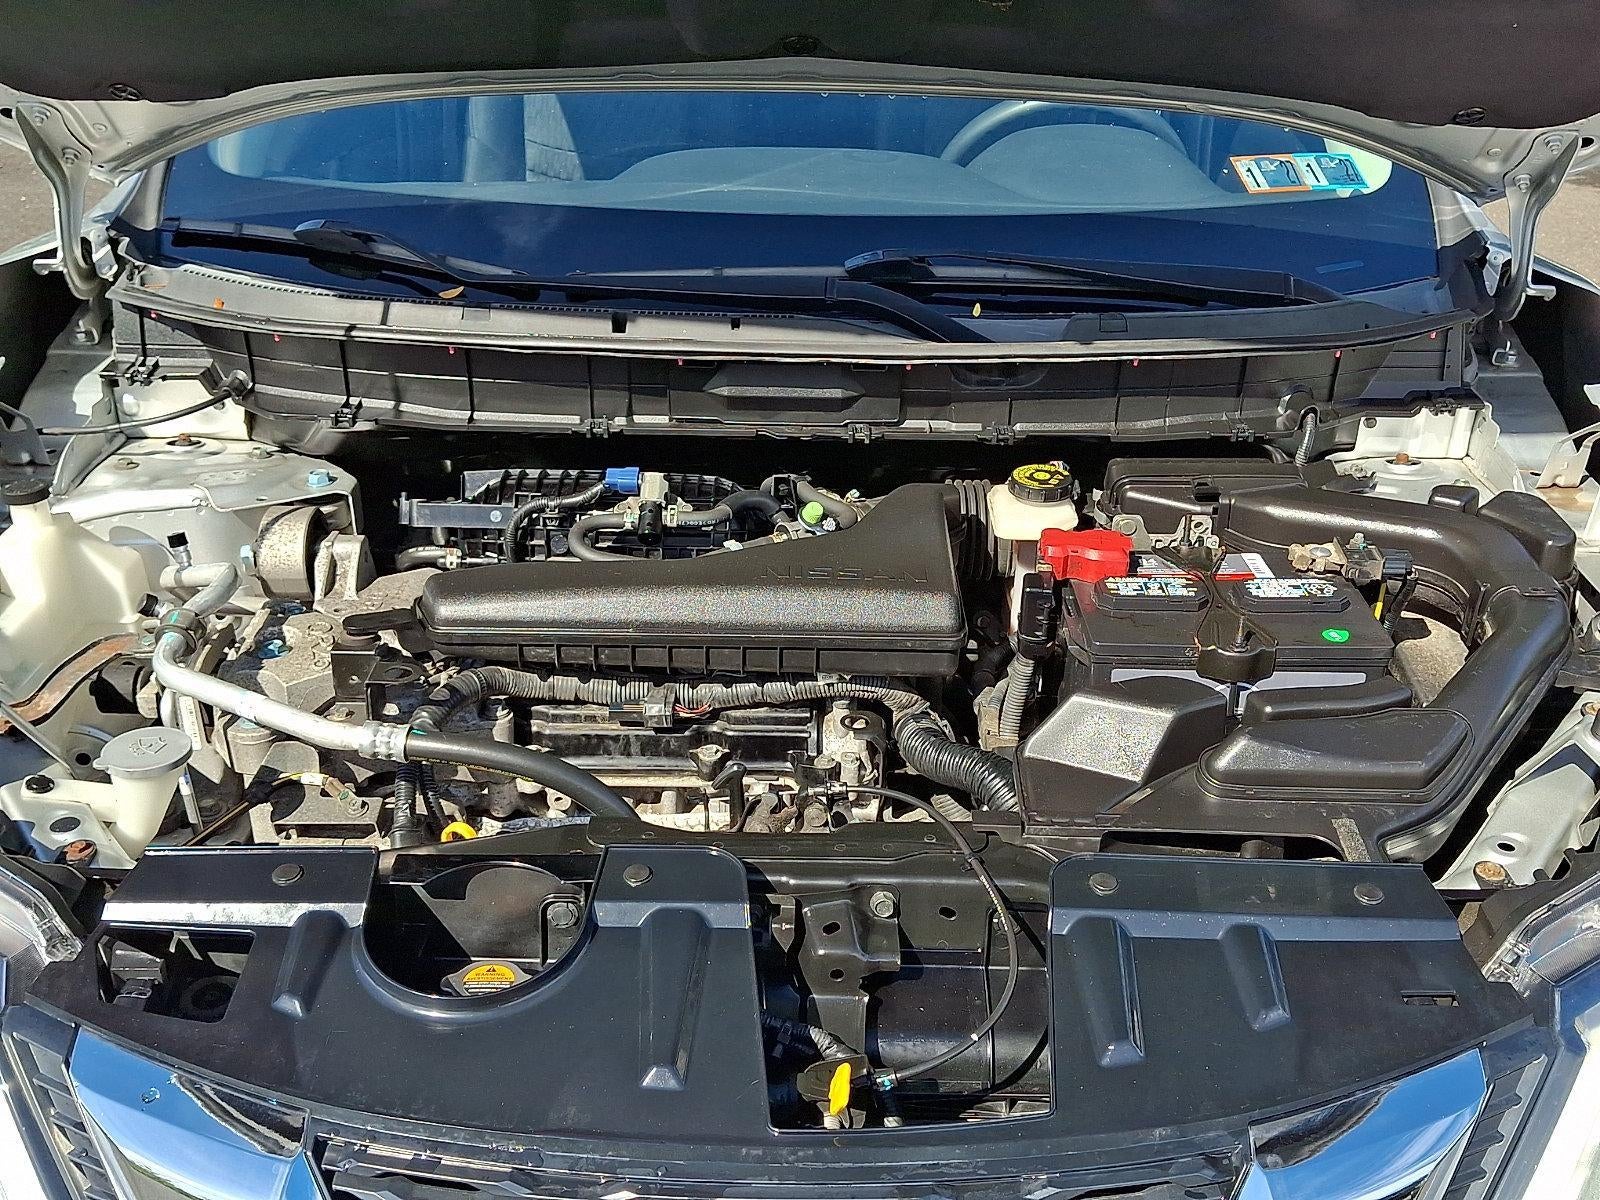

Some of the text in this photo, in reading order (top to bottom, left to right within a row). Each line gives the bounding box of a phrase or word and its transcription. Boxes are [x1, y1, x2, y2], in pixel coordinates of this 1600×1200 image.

[1246, 167, 1262, 188] 1
[1306, 162, 1321, 184] 1
[760, 564, 929, 583] NISSAN
